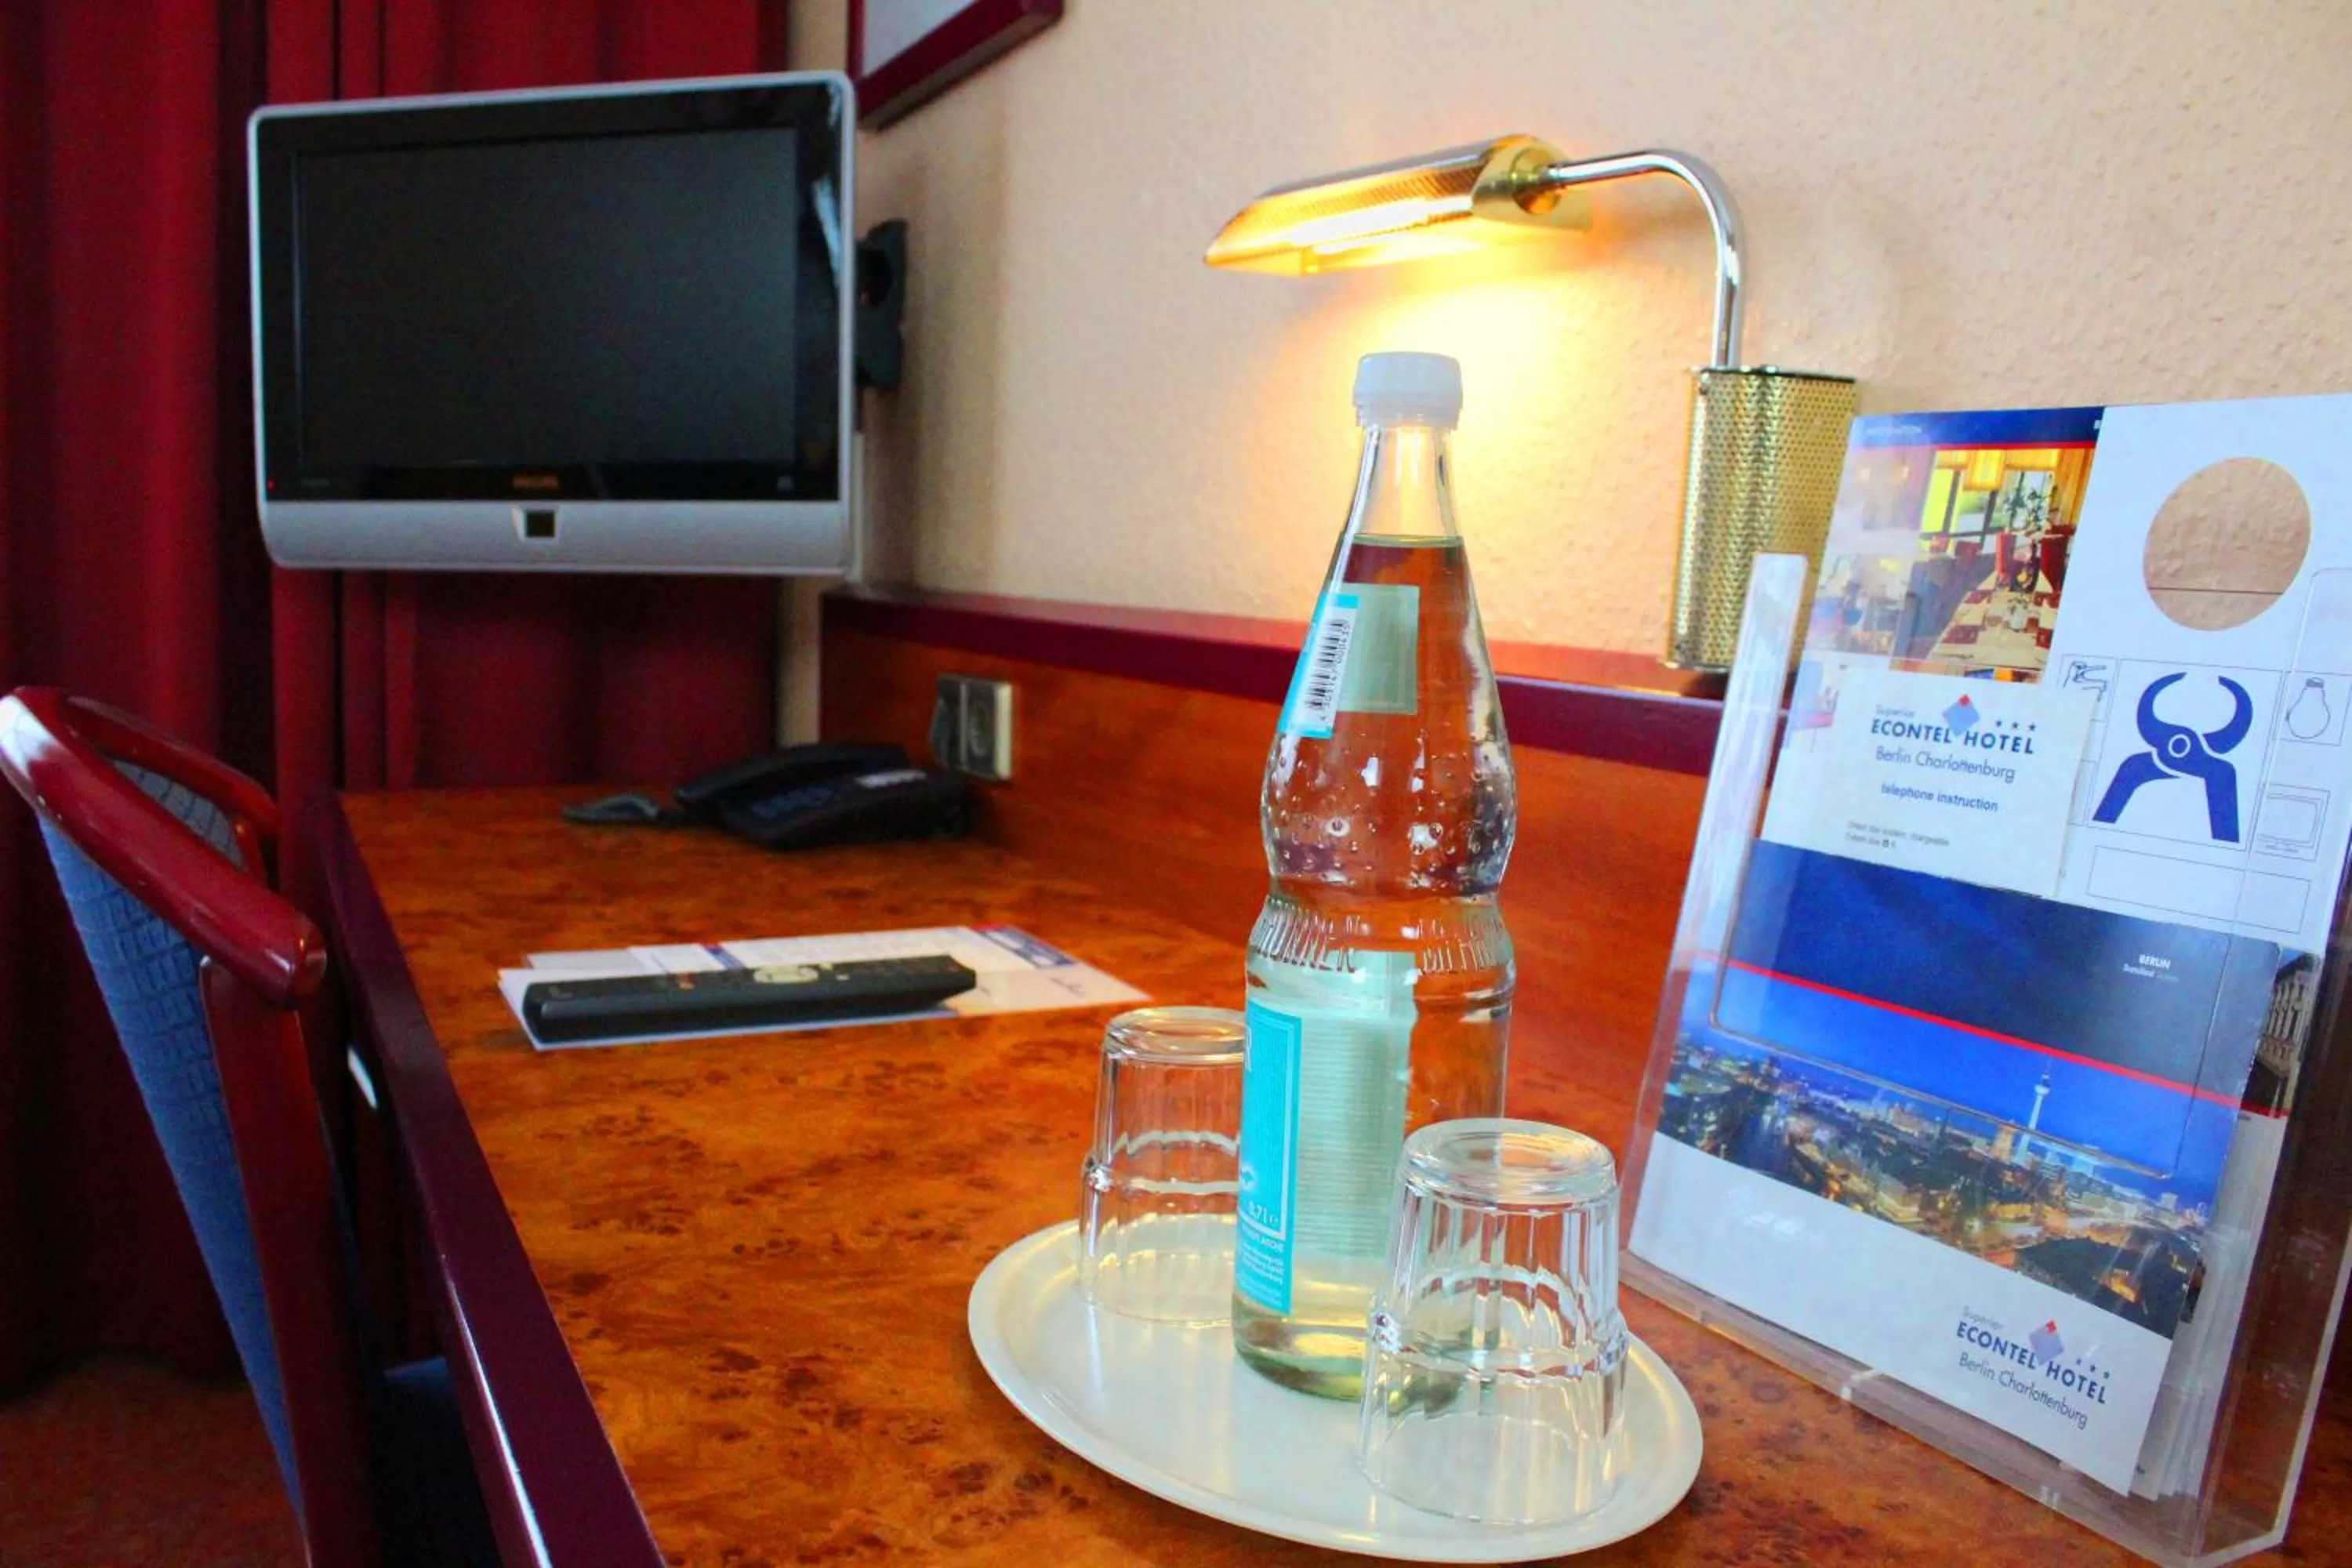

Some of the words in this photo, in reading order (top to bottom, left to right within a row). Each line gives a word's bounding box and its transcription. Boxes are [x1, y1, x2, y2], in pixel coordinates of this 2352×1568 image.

[1871, 718, 1952, 744] ECONTEL
[1963, 730, 2035, 755] HOTEL
[1875, 745, 1911, 764] Berlin
[1915, 750, 2016, 783] Charlottenburg
[1881, 783, 1934, 801] telephone
[1936, 791, 1998, 812] instruction
[1956, 1320, 2037, 1370] ECONTEL
[2045, 1360, 2106, 1404] HOTEL
[1958, 1352, 1994, 1381] Berlin
[1998, 1370, 2088, 1430] Charlottenburg
